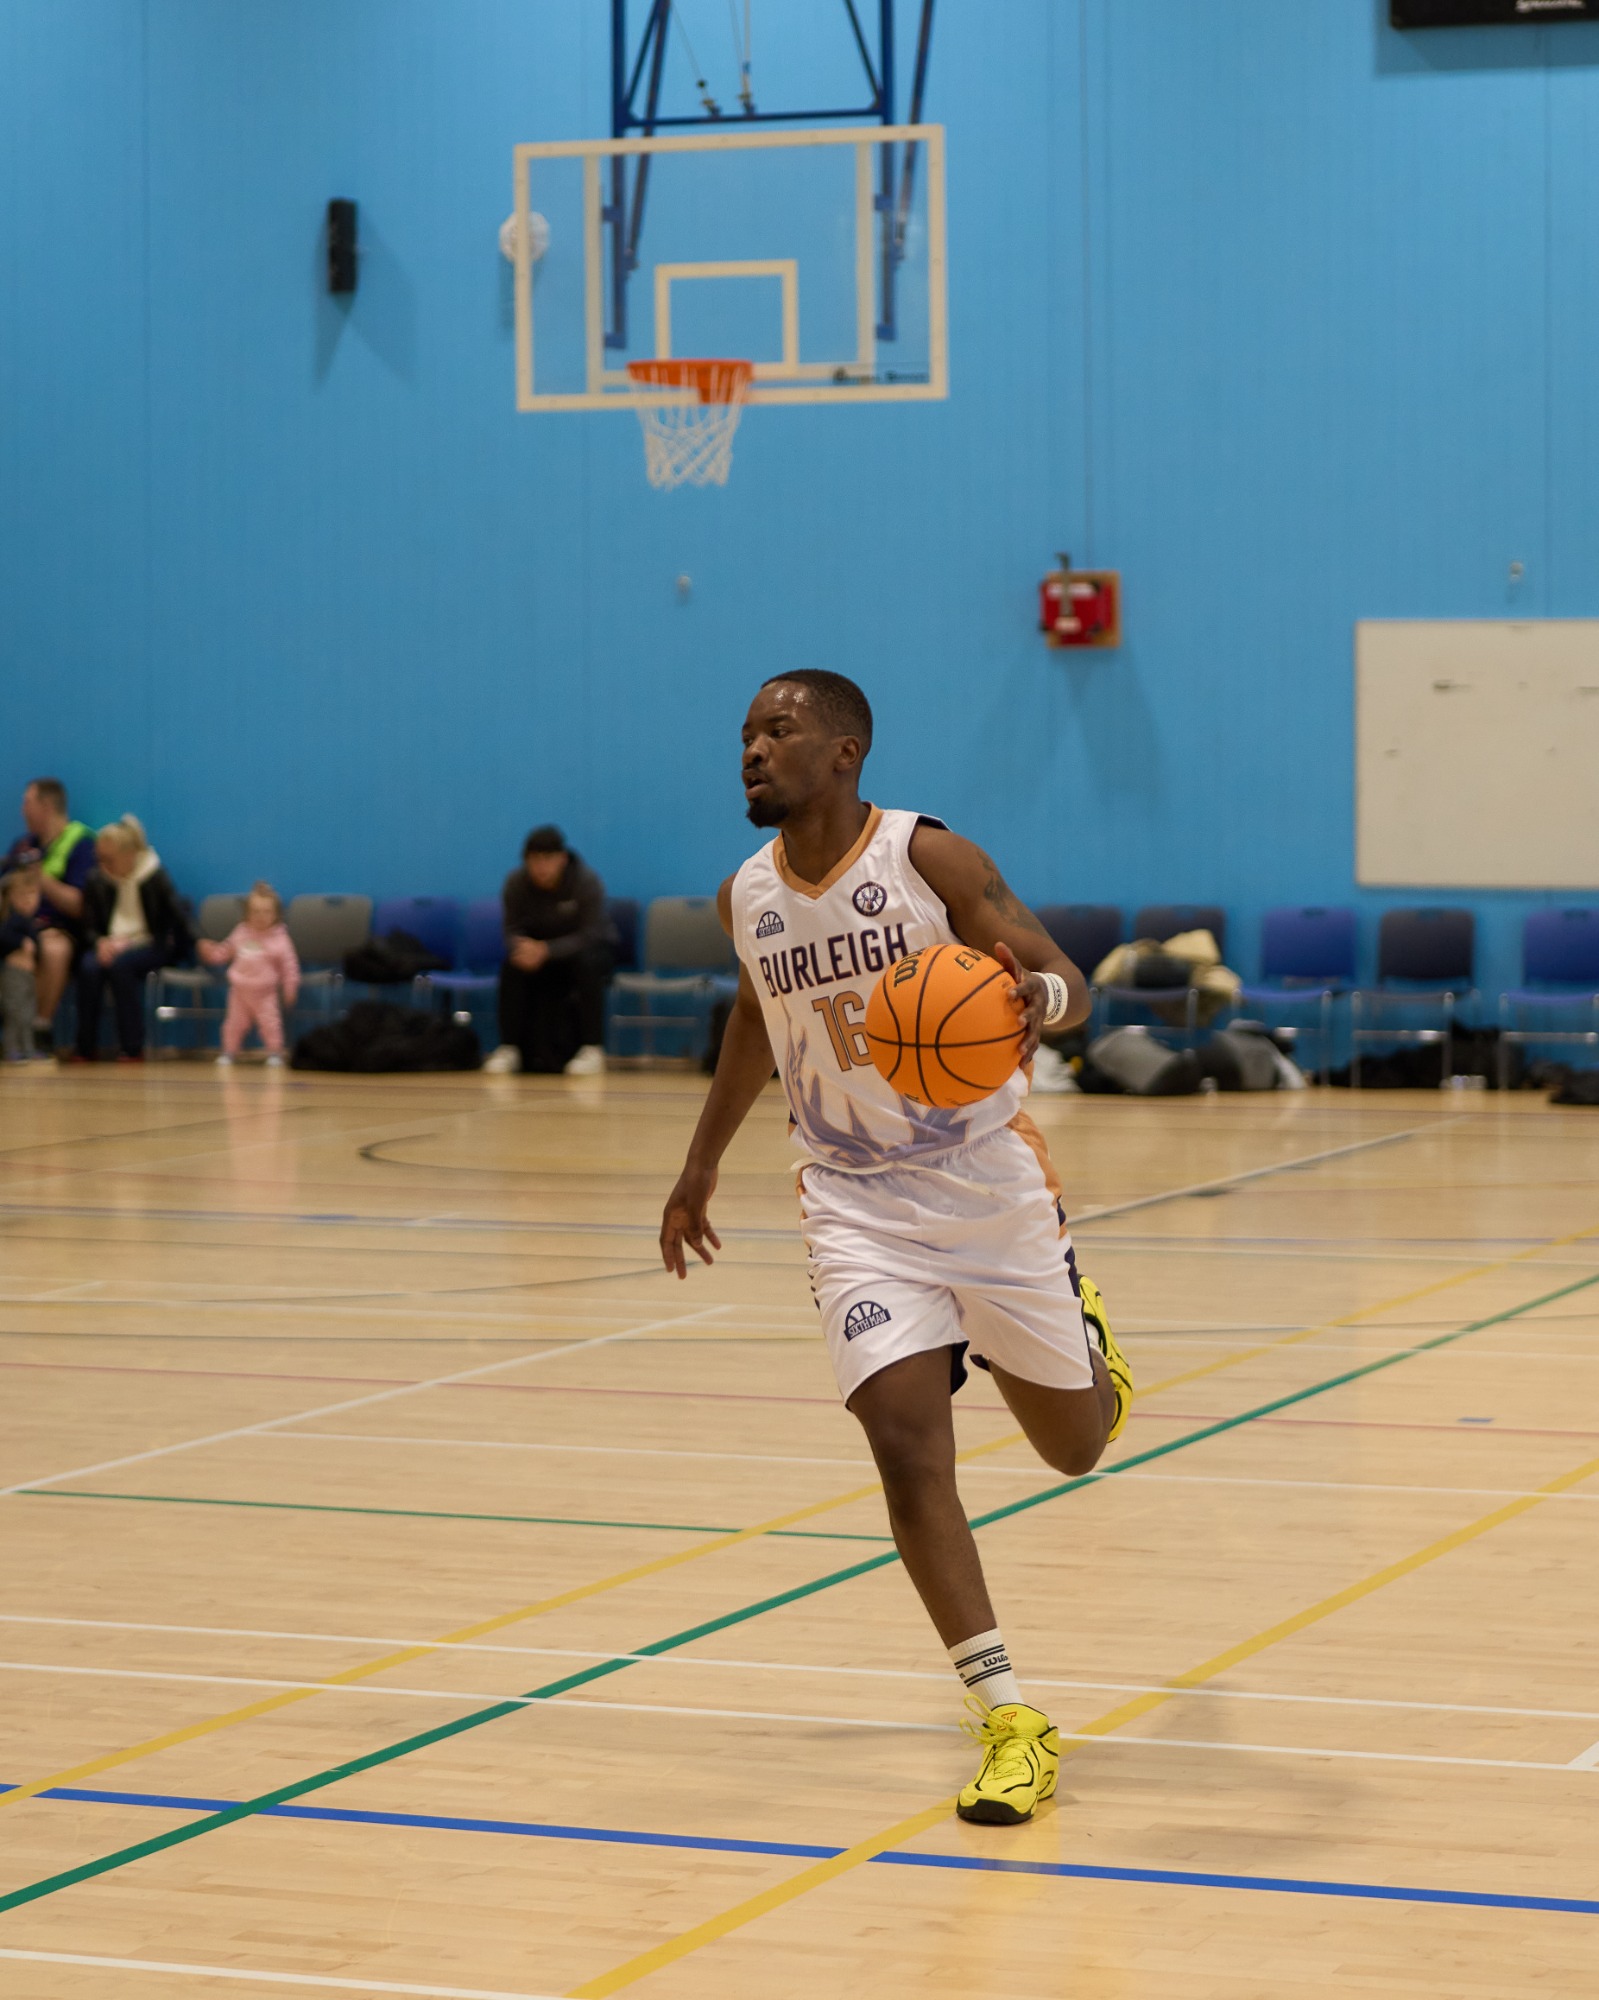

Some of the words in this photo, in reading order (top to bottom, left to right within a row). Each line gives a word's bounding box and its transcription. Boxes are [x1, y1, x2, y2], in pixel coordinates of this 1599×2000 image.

[759, 923, 909, 998] BURLEIGH
[811, 990, 874, 1072] 16
[848, 1317, 870, 1337] SIXTH
[869, 1310, 888, 1326] MAN
